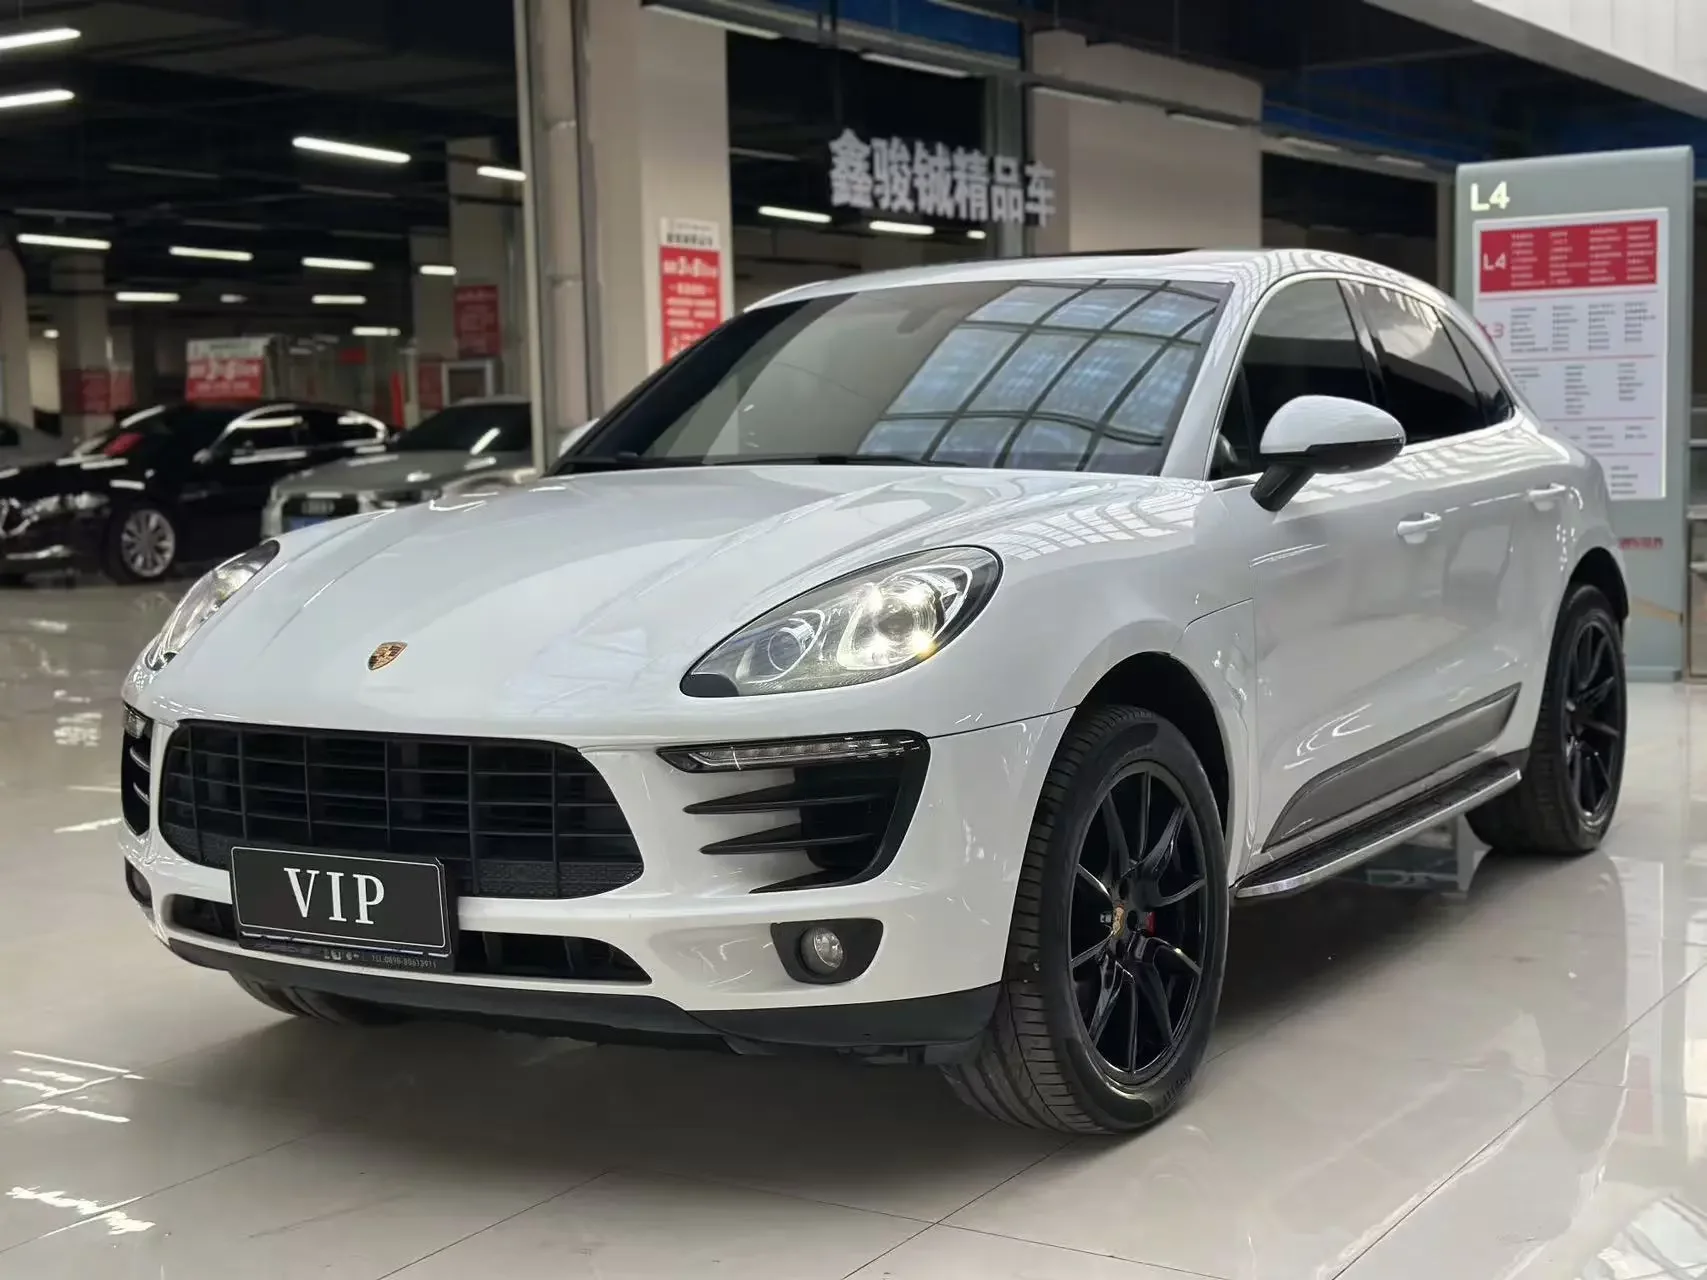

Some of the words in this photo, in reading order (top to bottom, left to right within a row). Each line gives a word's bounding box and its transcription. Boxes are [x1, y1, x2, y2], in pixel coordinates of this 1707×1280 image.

[1470, 181, 1510, 211] L4
[1482, 252, 1507, 271] L4
[283, 867, 385, 925] VIP
